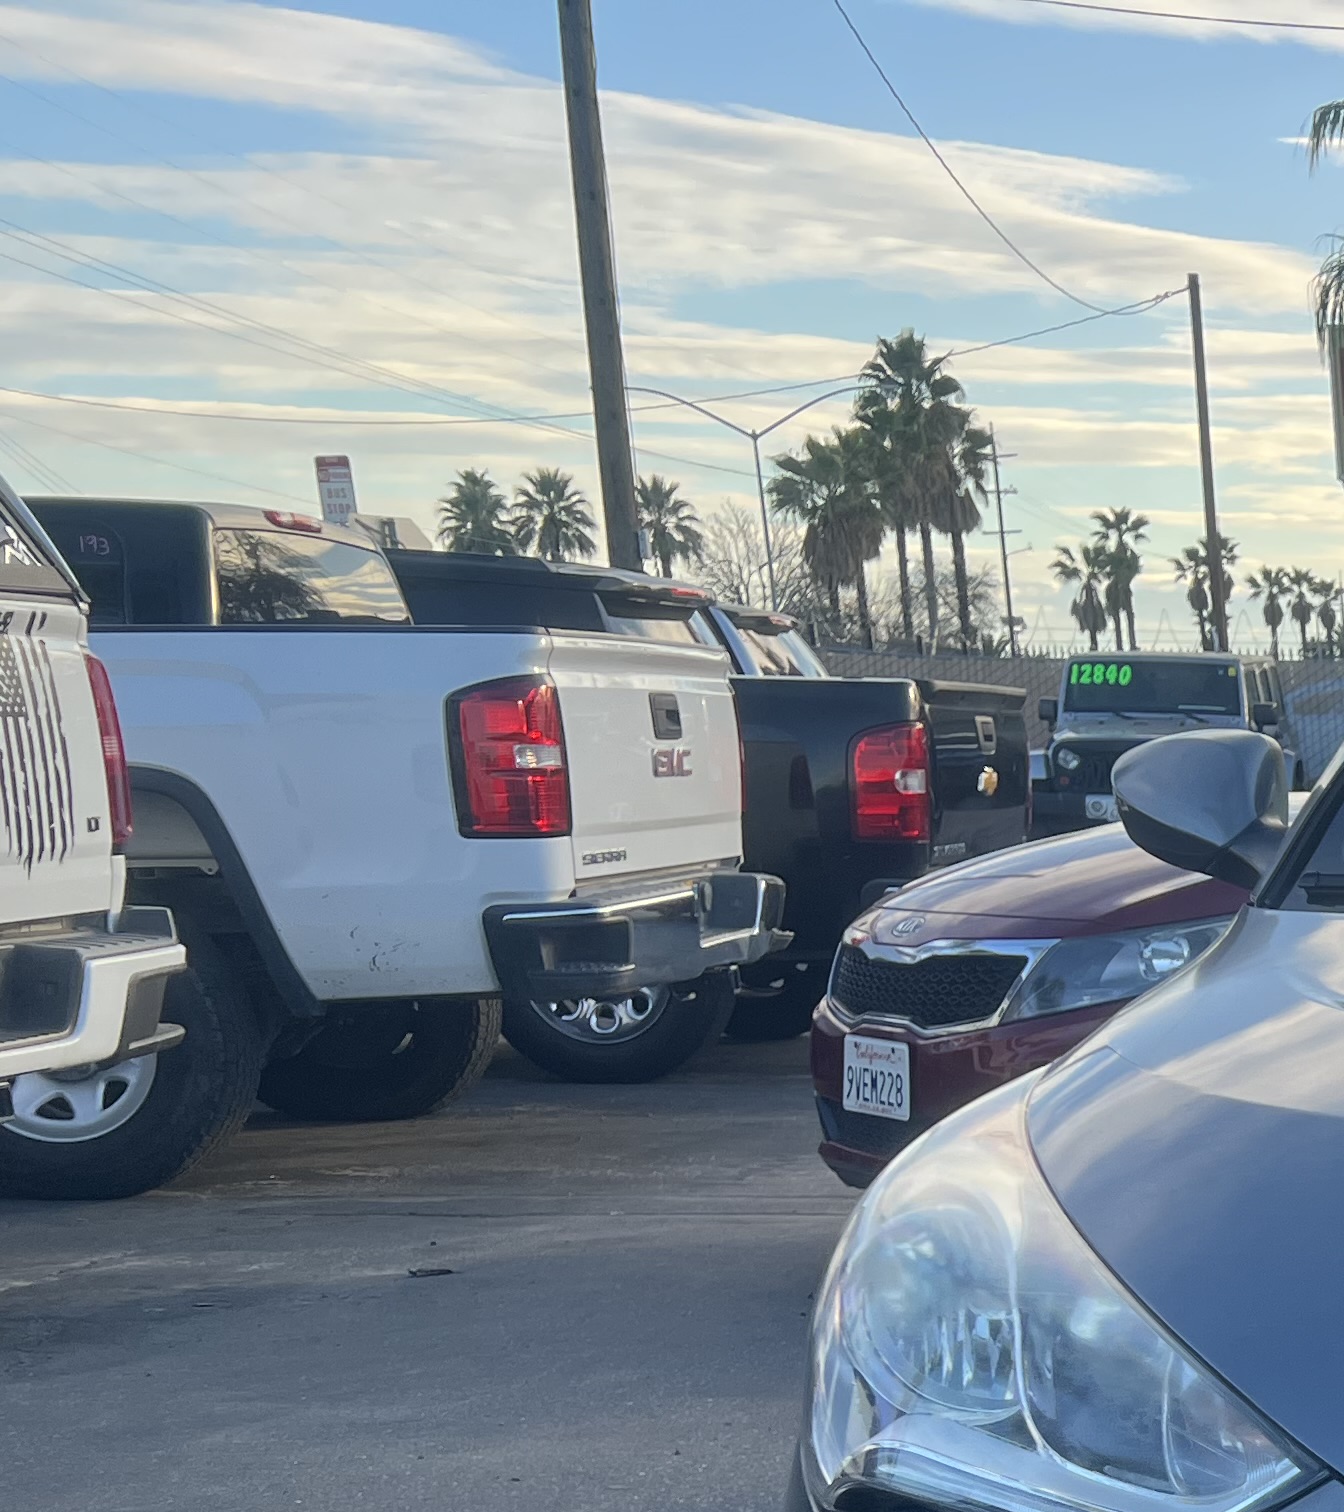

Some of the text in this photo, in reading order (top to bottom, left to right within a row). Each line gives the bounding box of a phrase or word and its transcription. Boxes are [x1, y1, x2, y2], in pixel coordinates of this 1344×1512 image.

[326, 487, 347, 499] BUS
[327, 503, 351, 514] STOP
[79, 535, 110, 556] 193
[1070, 663, 1133, 687] 12840
[582, 849, 627, 866] SIERRA
[846, 1065, 904, 1108] 9VEM228
